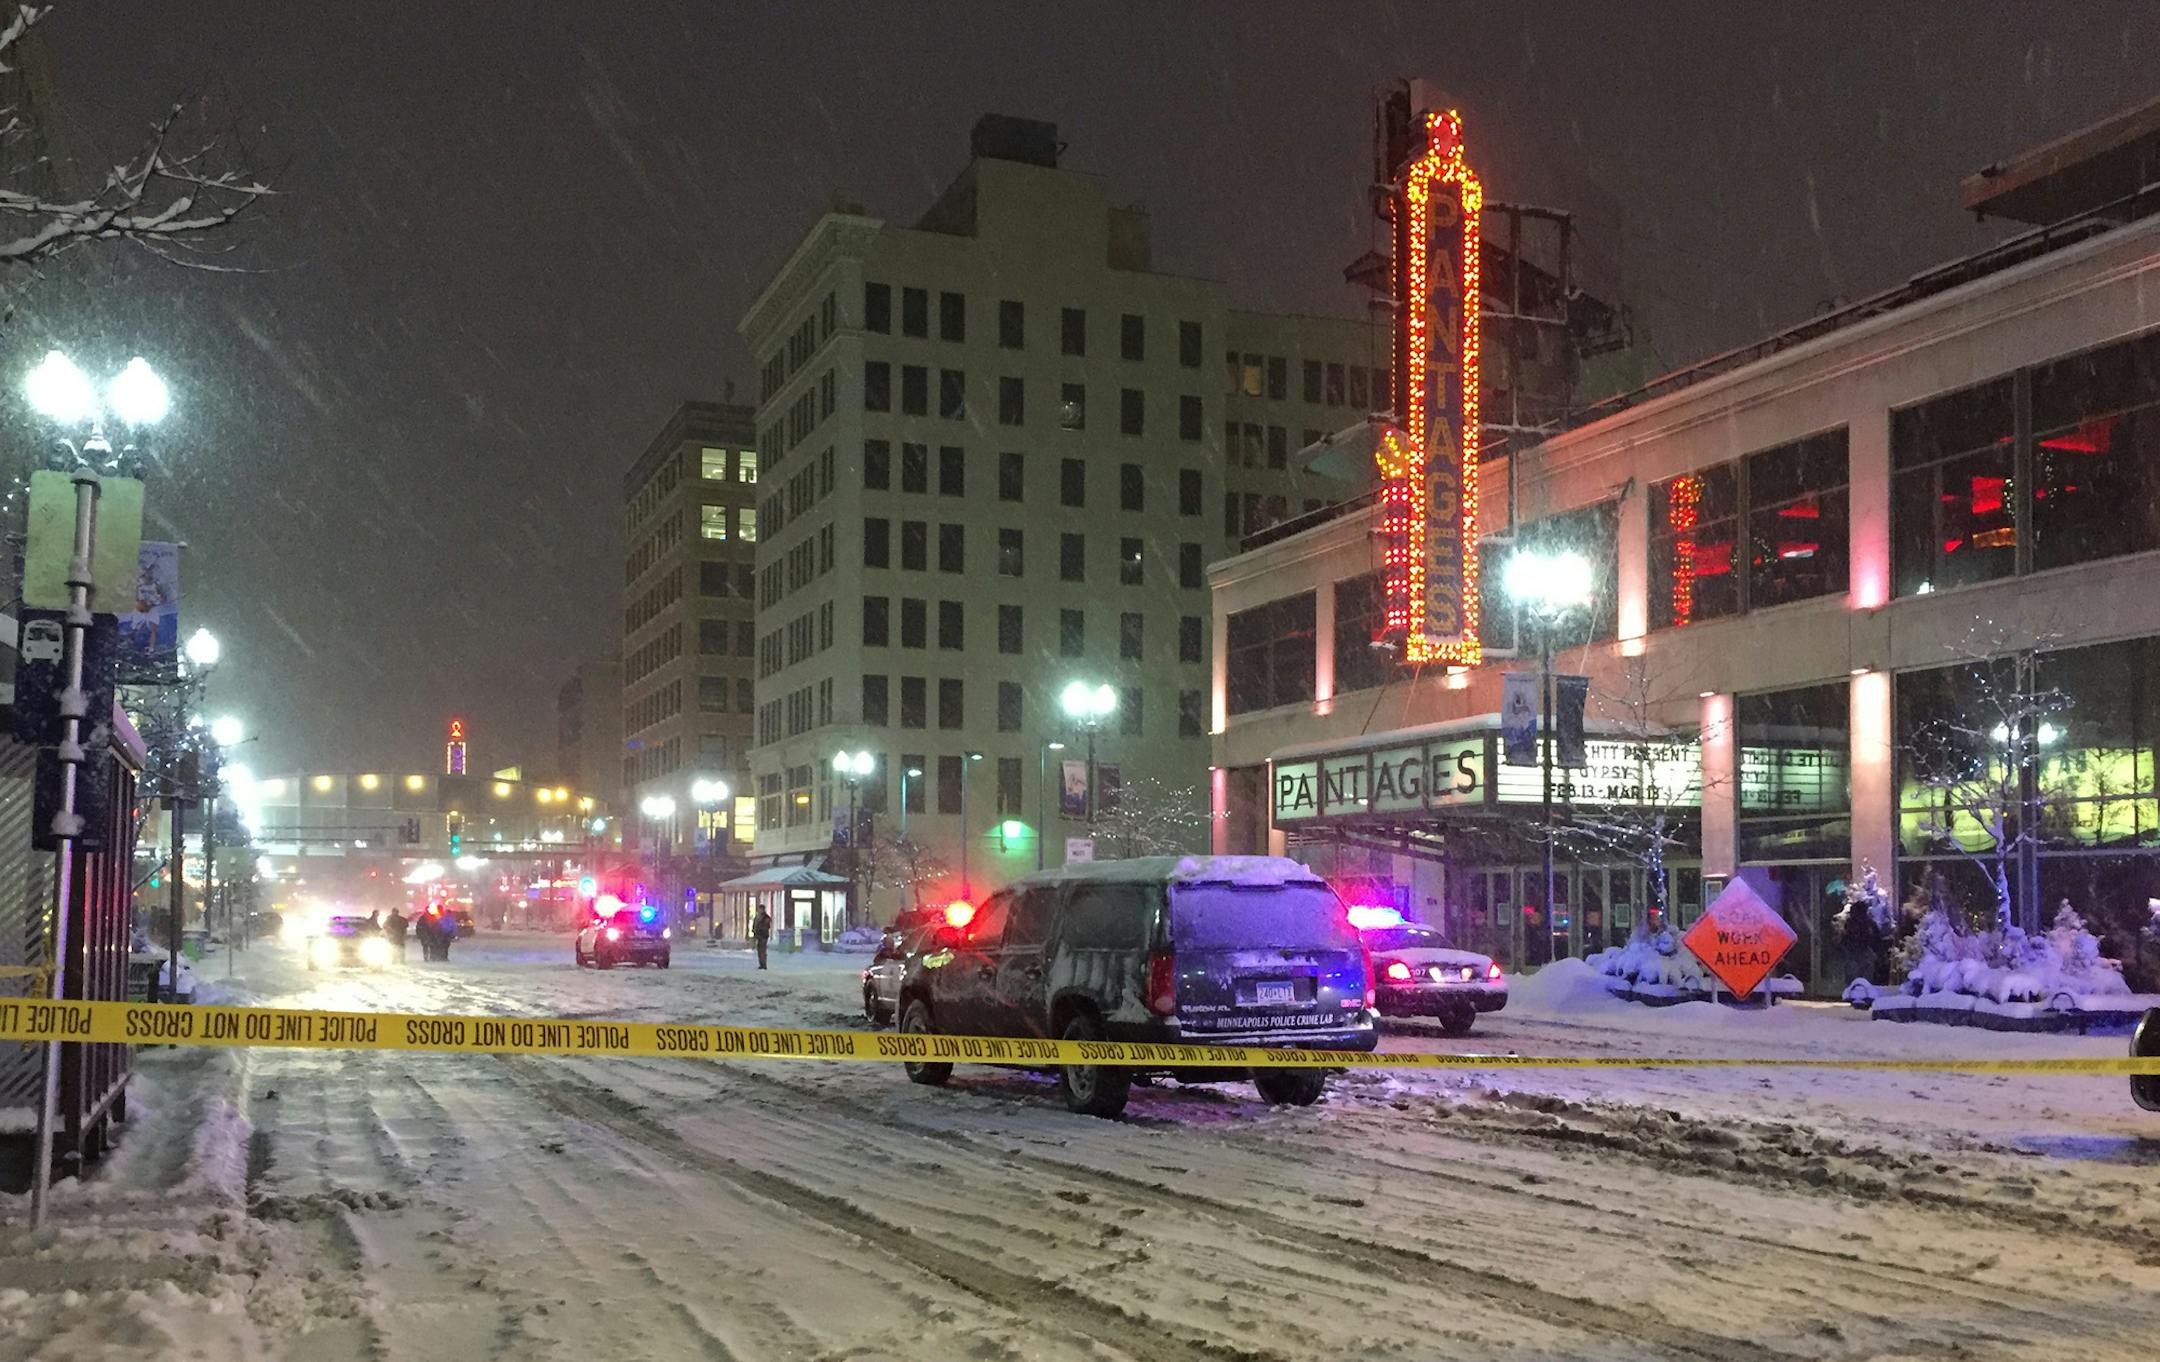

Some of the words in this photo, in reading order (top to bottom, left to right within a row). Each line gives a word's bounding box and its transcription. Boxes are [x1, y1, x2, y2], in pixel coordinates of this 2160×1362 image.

[1426, 192, 1460, 634] PANTAGES
[1280, 750, 1476, 811] PANTAGES
[1714, 950, 1771, 966] AHEAD
[0, 1004, 19, 1032] LI
[26, 1006, 92, 1034] POLICE
[126, 1009, 193, 1037] CROSS
[201, 1012, 240, 1038] NOT
[245, 1014, 271, 1039] DO
[275, 1015, 312, 1040] LINE
[319, 1017, 377, 1042] POLICE
[1217, 1015, 1269, 1028] MINNEAPOLIS
[1270, 1015, 1296, 1027] POLICE
[1297, 1014, 1319, 1026] CRIME
[1320, 1013, 1334, 1025] LAB
[406, 1020, 465, 1045] CROSS
[471, 1022, 506, 1046] NOT
[511, 1023, 533, 1047] DO
[537, 1024, 570, 1048] LINE
[576, 1025, 629, 1049] POLICE
[656, 1029, 709, 1051] CROSS
[715, 1031, 745, 1053] NOT
[749, 1032, 770, 1053] DO
[772, 1032, 801, 1054] LINE
[807, 1033, 855, 1055] POLICE
[877, 1036, 927, 1056] CROSS
[932, 1037, 961, 1057] NOT
[961, 1039, 983, 1057] DO
[985, 1040, 1013, 1058] LINE
[1017, 1040, 1060, 1059] POLICE
